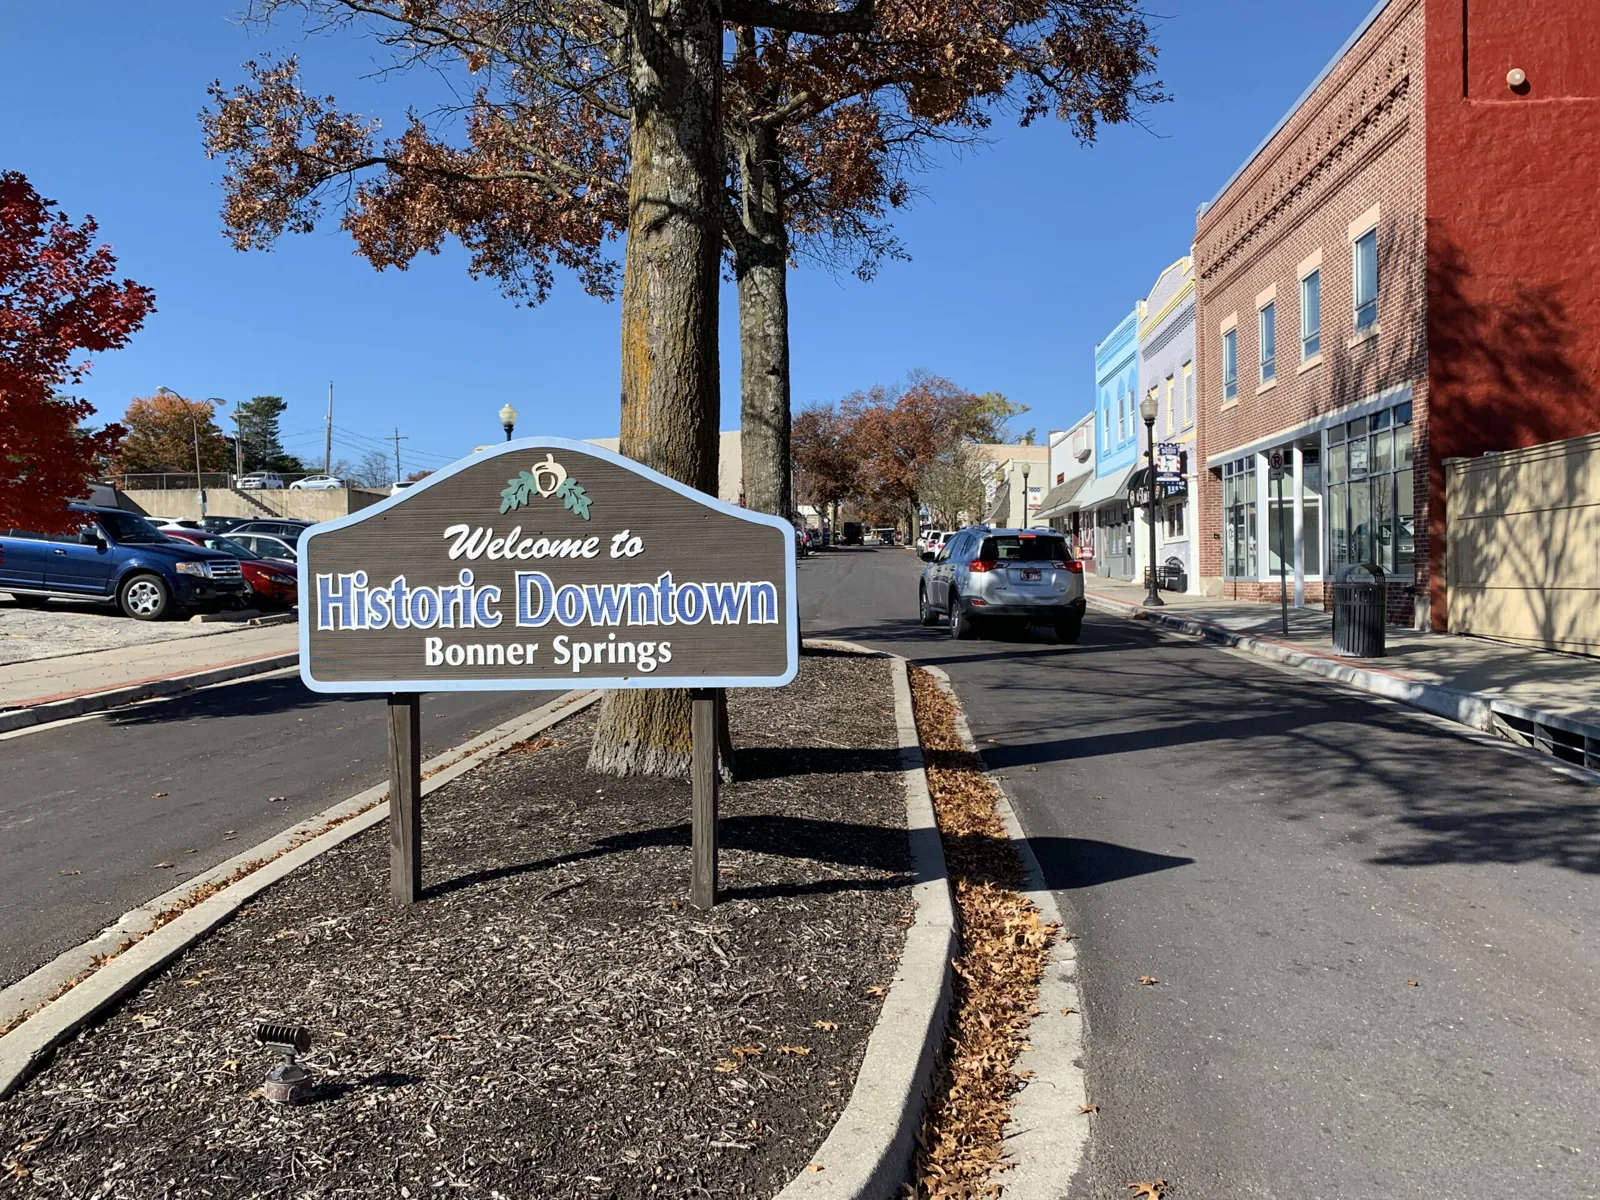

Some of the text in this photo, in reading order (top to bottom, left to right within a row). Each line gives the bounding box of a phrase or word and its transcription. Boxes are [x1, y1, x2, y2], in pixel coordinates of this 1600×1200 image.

[444, 524, 644, 560] Welcome to
[316, 568, 779, 631] Historic Downtown
[425, 632, 672, 673] Bonner Springs
